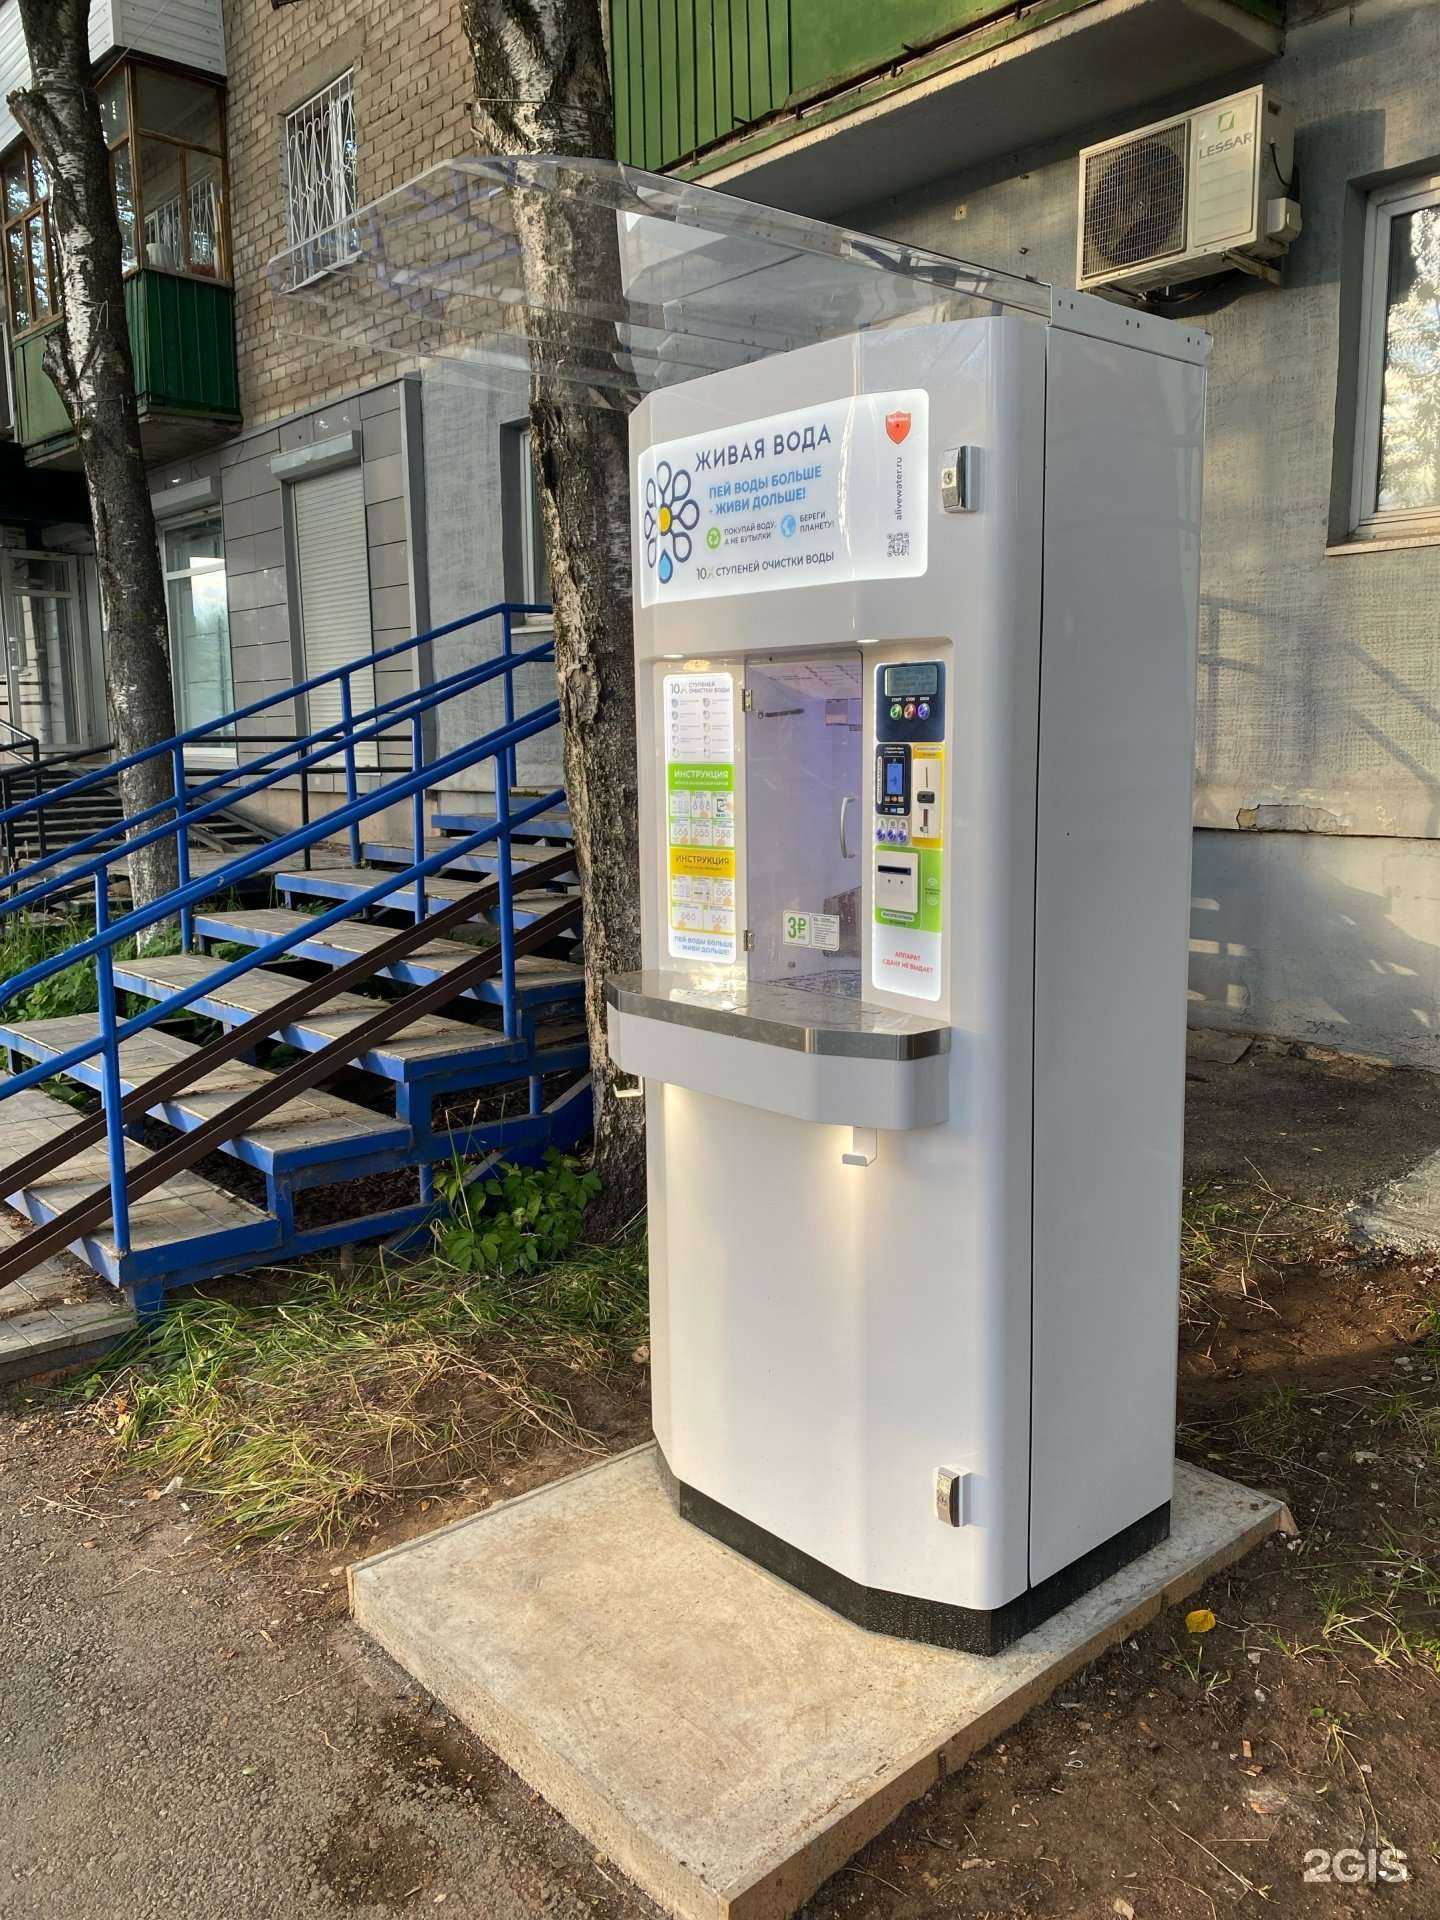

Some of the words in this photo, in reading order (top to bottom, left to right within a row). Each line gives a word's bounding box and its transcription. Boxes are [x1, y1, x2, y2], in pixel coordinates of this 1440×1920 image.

[1199, 132, 1253, 158] LESSAR
[695, 438, 765, 472] ЖИВАЯ
[773, 424, 831, 455] ВОДА
[709, 482, 731, 499] ПЕЙ
[734, 477, 768, 494] ВОДЫ
[771, 464, 822, 487] БОЛЬШЕ
[894, 456, 903, 520] alivewater.ru
[715, 499, 749, 515] ЖИВИ
[752, 487, 806, 511] ДОЛЬШЕ!
[799, 511, 826, 522] БЕРЕГИ
[724, 521, 755, 535] ПОКУПАЙ
[731, 536, 740, 544] НЕ
[740, 532, 771, 543] БУТЫЛКИ
[716, 561, 760, 577] СТУПЕНЕЙ
[762, 556, 804, 570] ОЧИСТКИ
[806, 552, 835, 564] ВОДЫ
[674, 768, 729, 780] ИНСТРУКЦИЯ
[676, 855, 730, 866] ИНСТРУКЦИЯ
[895, 951, 921, 961] АППАРАТ
